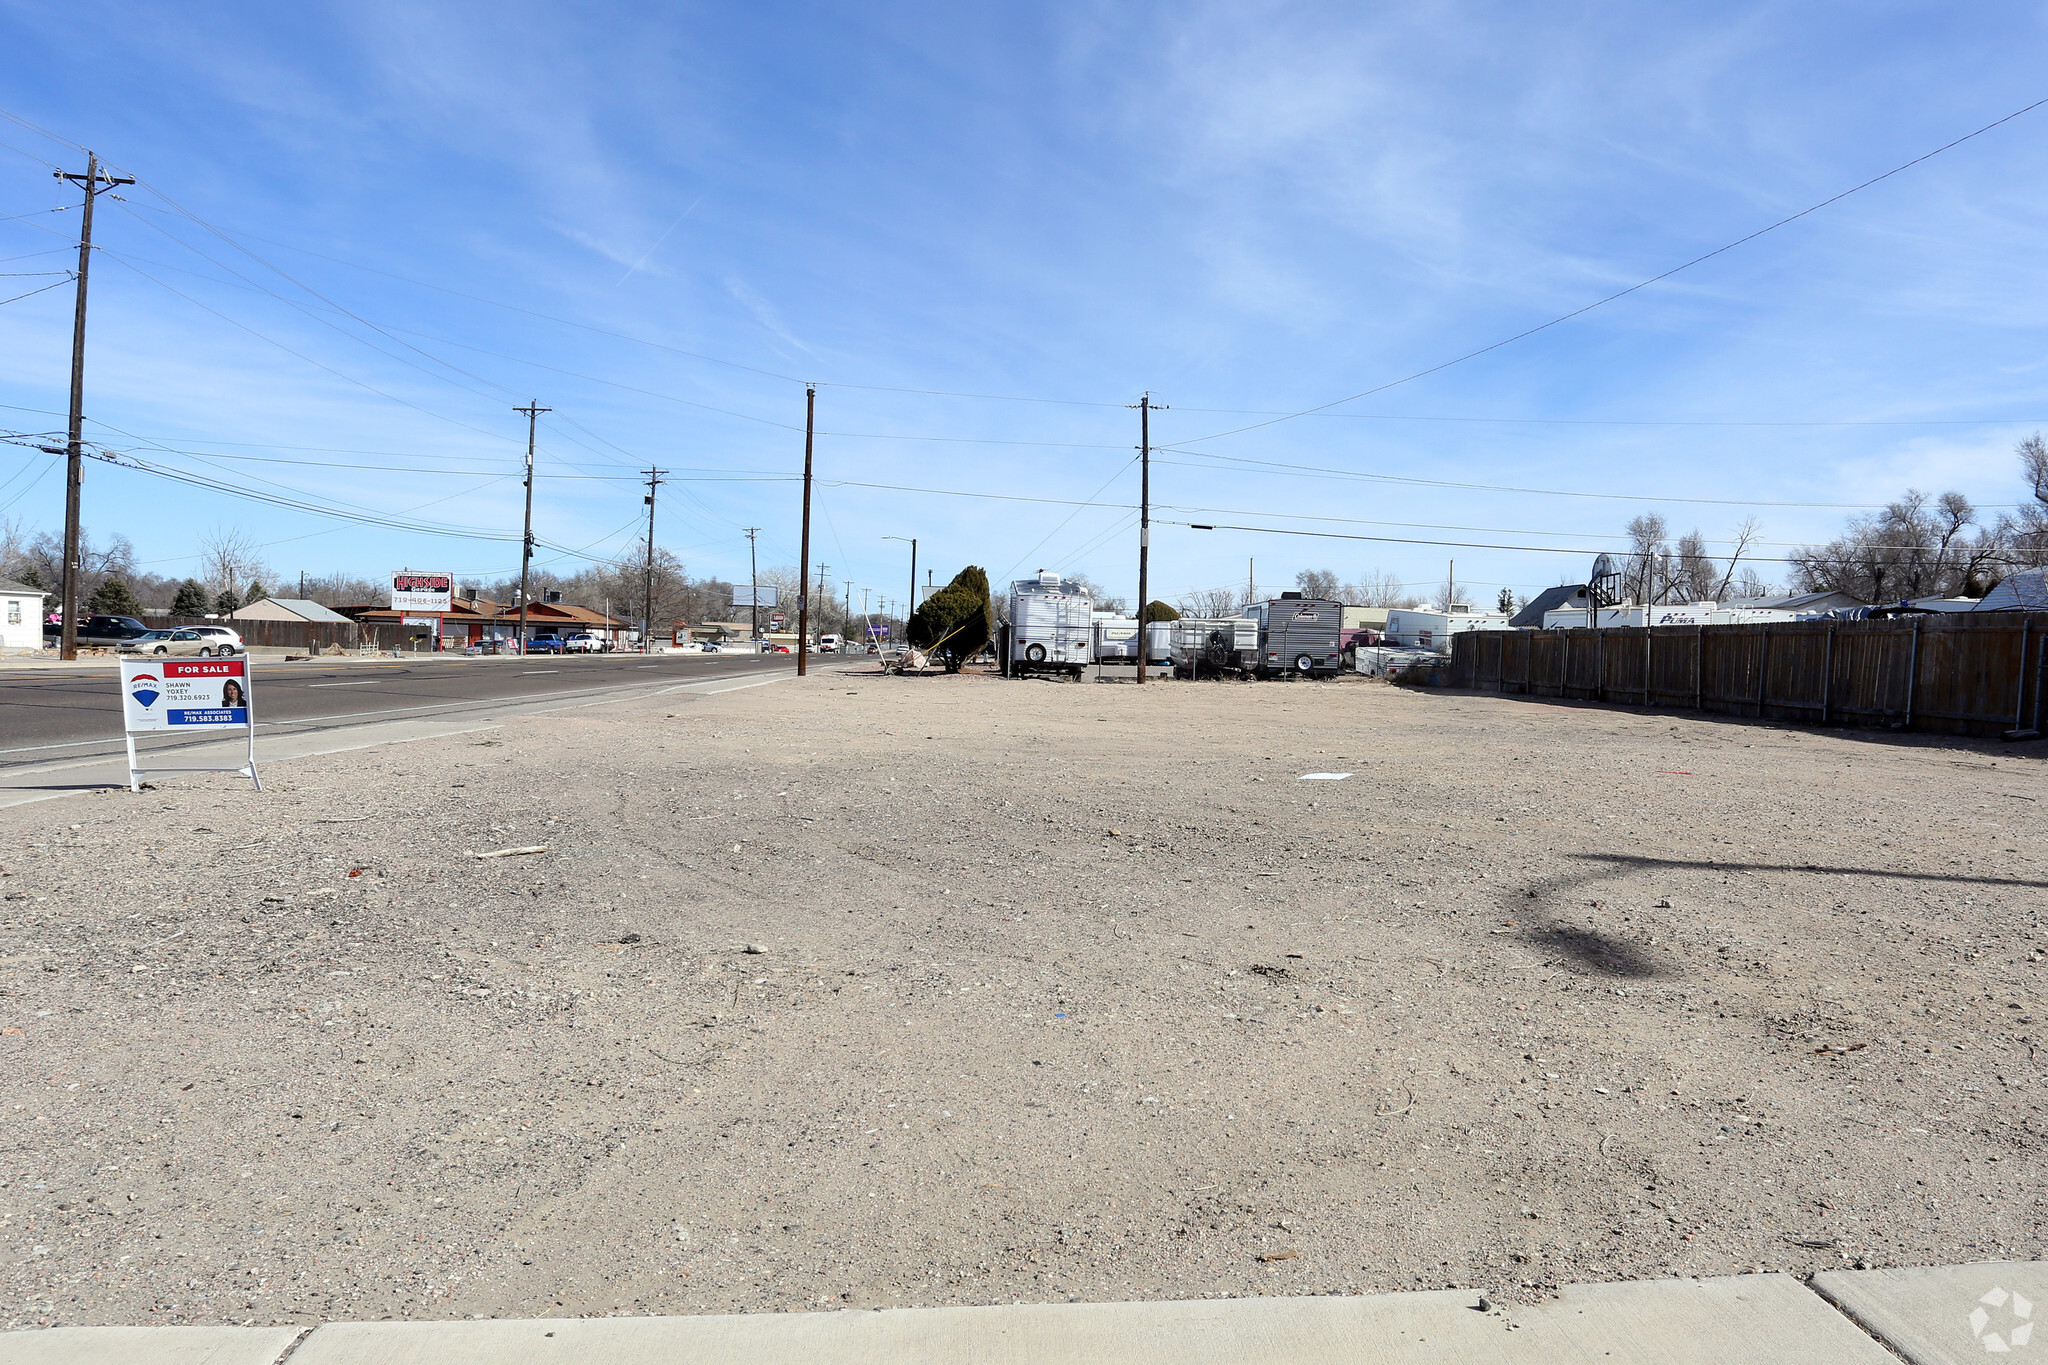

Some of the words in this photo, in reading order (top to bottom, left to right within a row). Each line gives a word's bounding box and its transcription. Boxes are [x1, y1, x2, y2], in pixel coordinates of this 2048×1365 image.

[397, 576, 448, 590] HIGHSIDE
[178, 666, 199, 674] FOR
[202, 665, 229, 673] SALE
